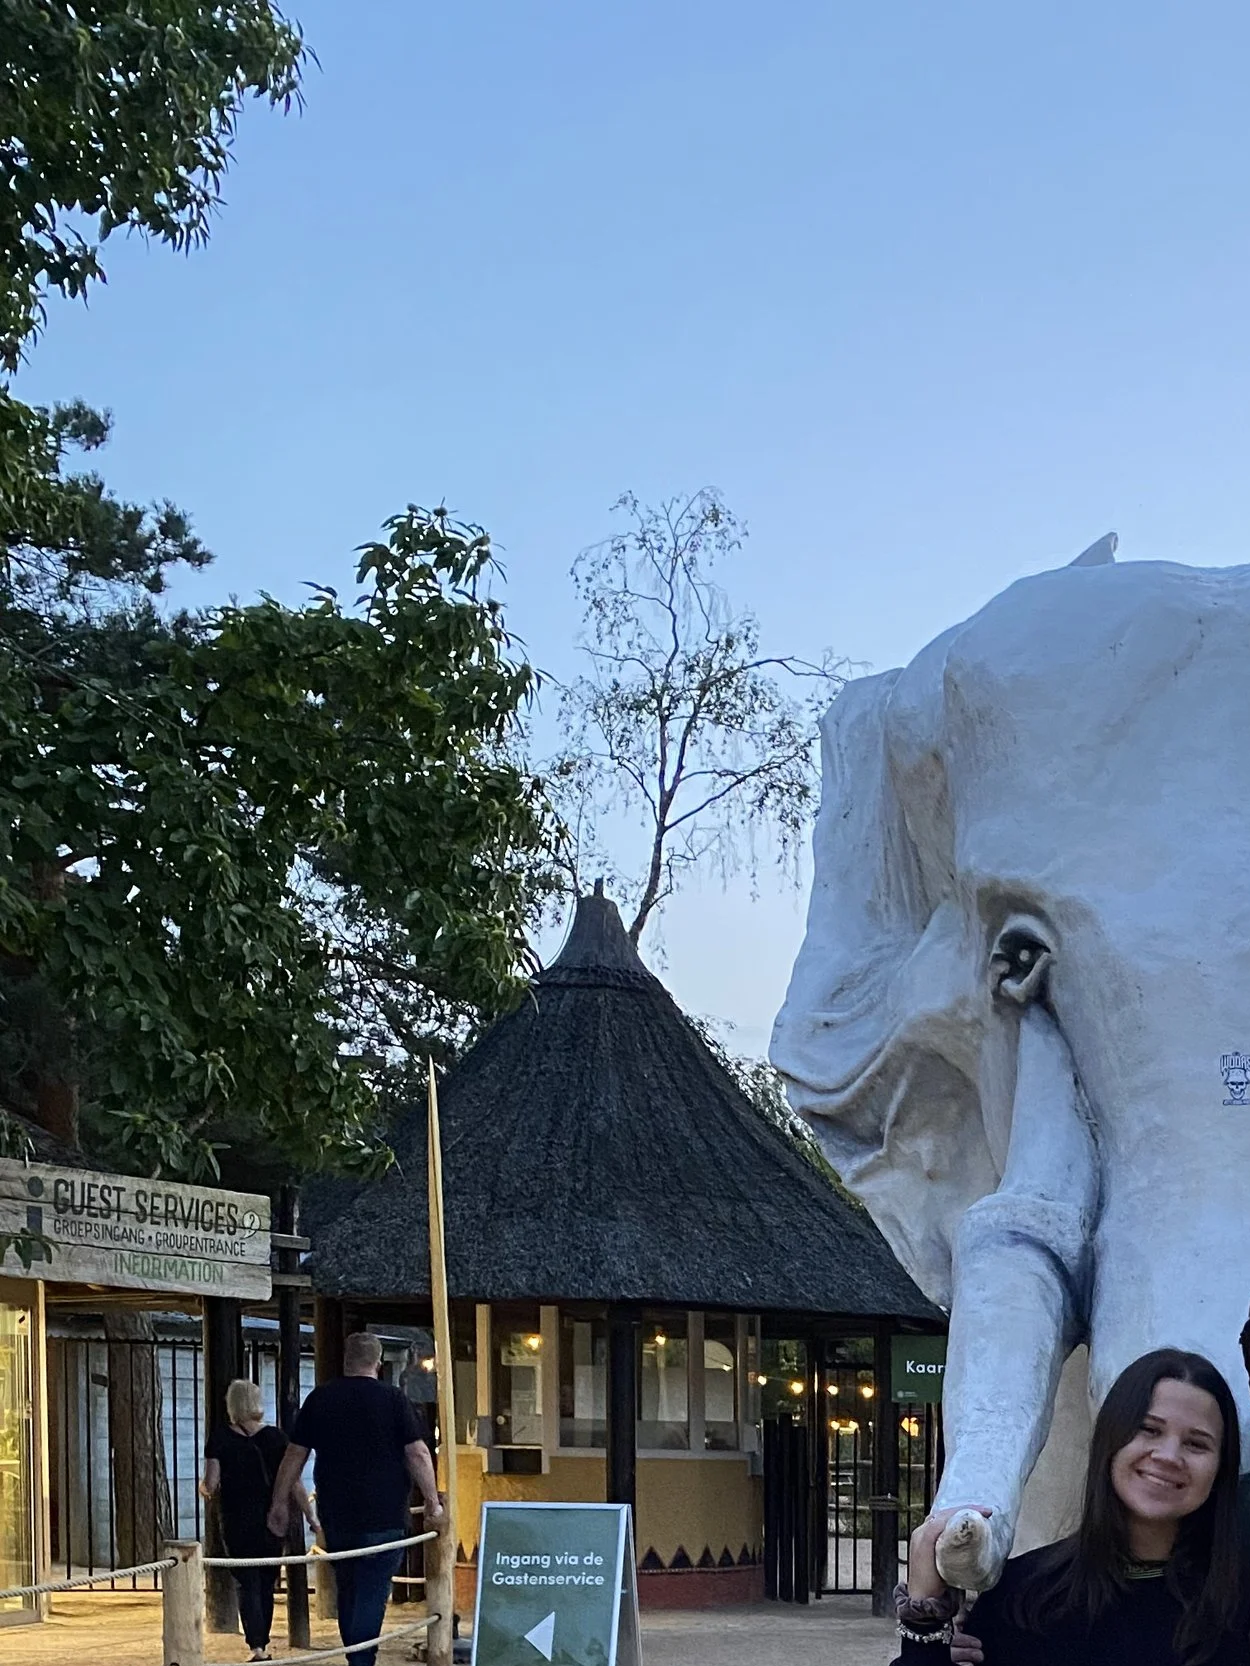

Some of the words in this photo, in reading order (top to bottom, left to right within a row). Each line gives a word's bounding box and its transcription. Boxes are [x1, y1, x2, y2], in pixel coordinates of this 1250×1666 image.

[53, 1178, 126, 1222] GUEST
[135, 1189, 239, 1236] SERVICES
[53, 1219, 145, 1244] GROEPSINGANG
[155, 1232, 246, 1257] GROUPENTRANCE
[114, 1253, 223, 1283] INFORMATION
[906, 1360, 946, 1374] Kaar
[496, 1552, 551, 1569] Ingang
[554, 1552, 579, 1566] via
[583, 1552, 604, 1566] de
[492, 1571, 605, 1586] Gastenservice
